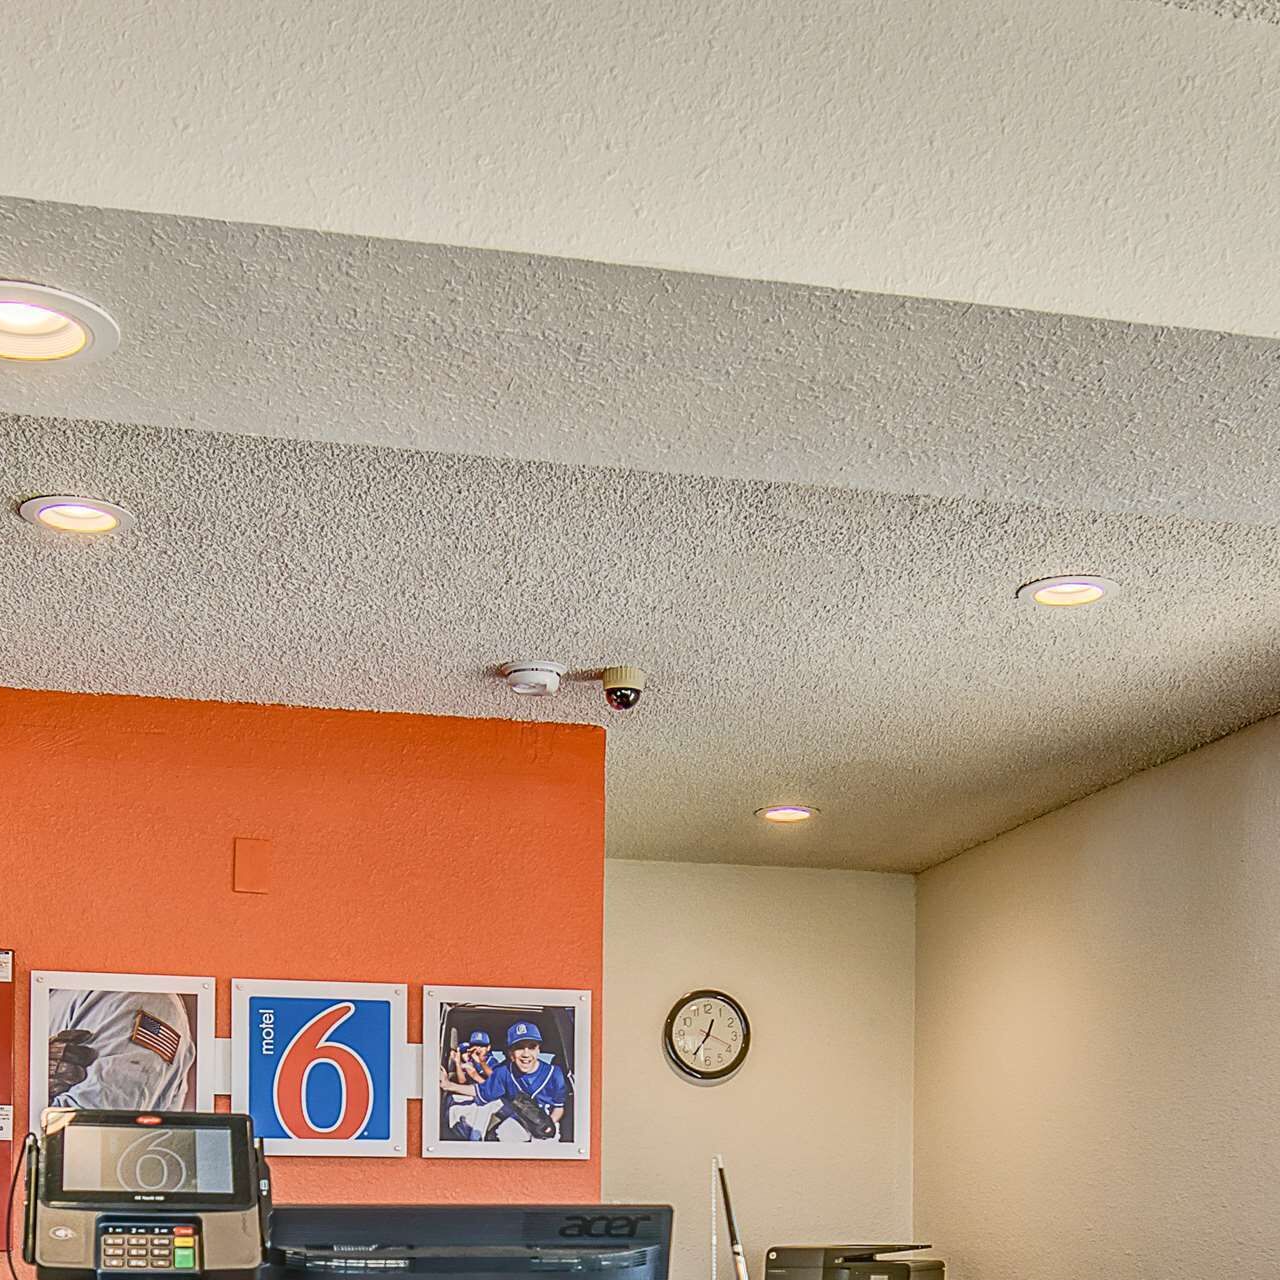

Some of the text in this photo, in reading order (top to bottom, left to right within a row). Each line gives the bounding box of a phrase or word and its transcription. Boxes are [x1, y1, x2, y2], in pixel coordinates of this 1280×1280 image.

[703, 1003, 713, 1015] 12
[682, 1017, 692, 1028] 10
[727, 1017, 735, 1028] 2
[259, 1009, 274, 1055] motel
[731, 1031, 738, 1042] 3
[704, 1055, 712, 1067] 6
[717, 1053, 724, 1063] 5
[273, 1001, 375, 1140] 6
[559, 1215, 651, 1238] acer
